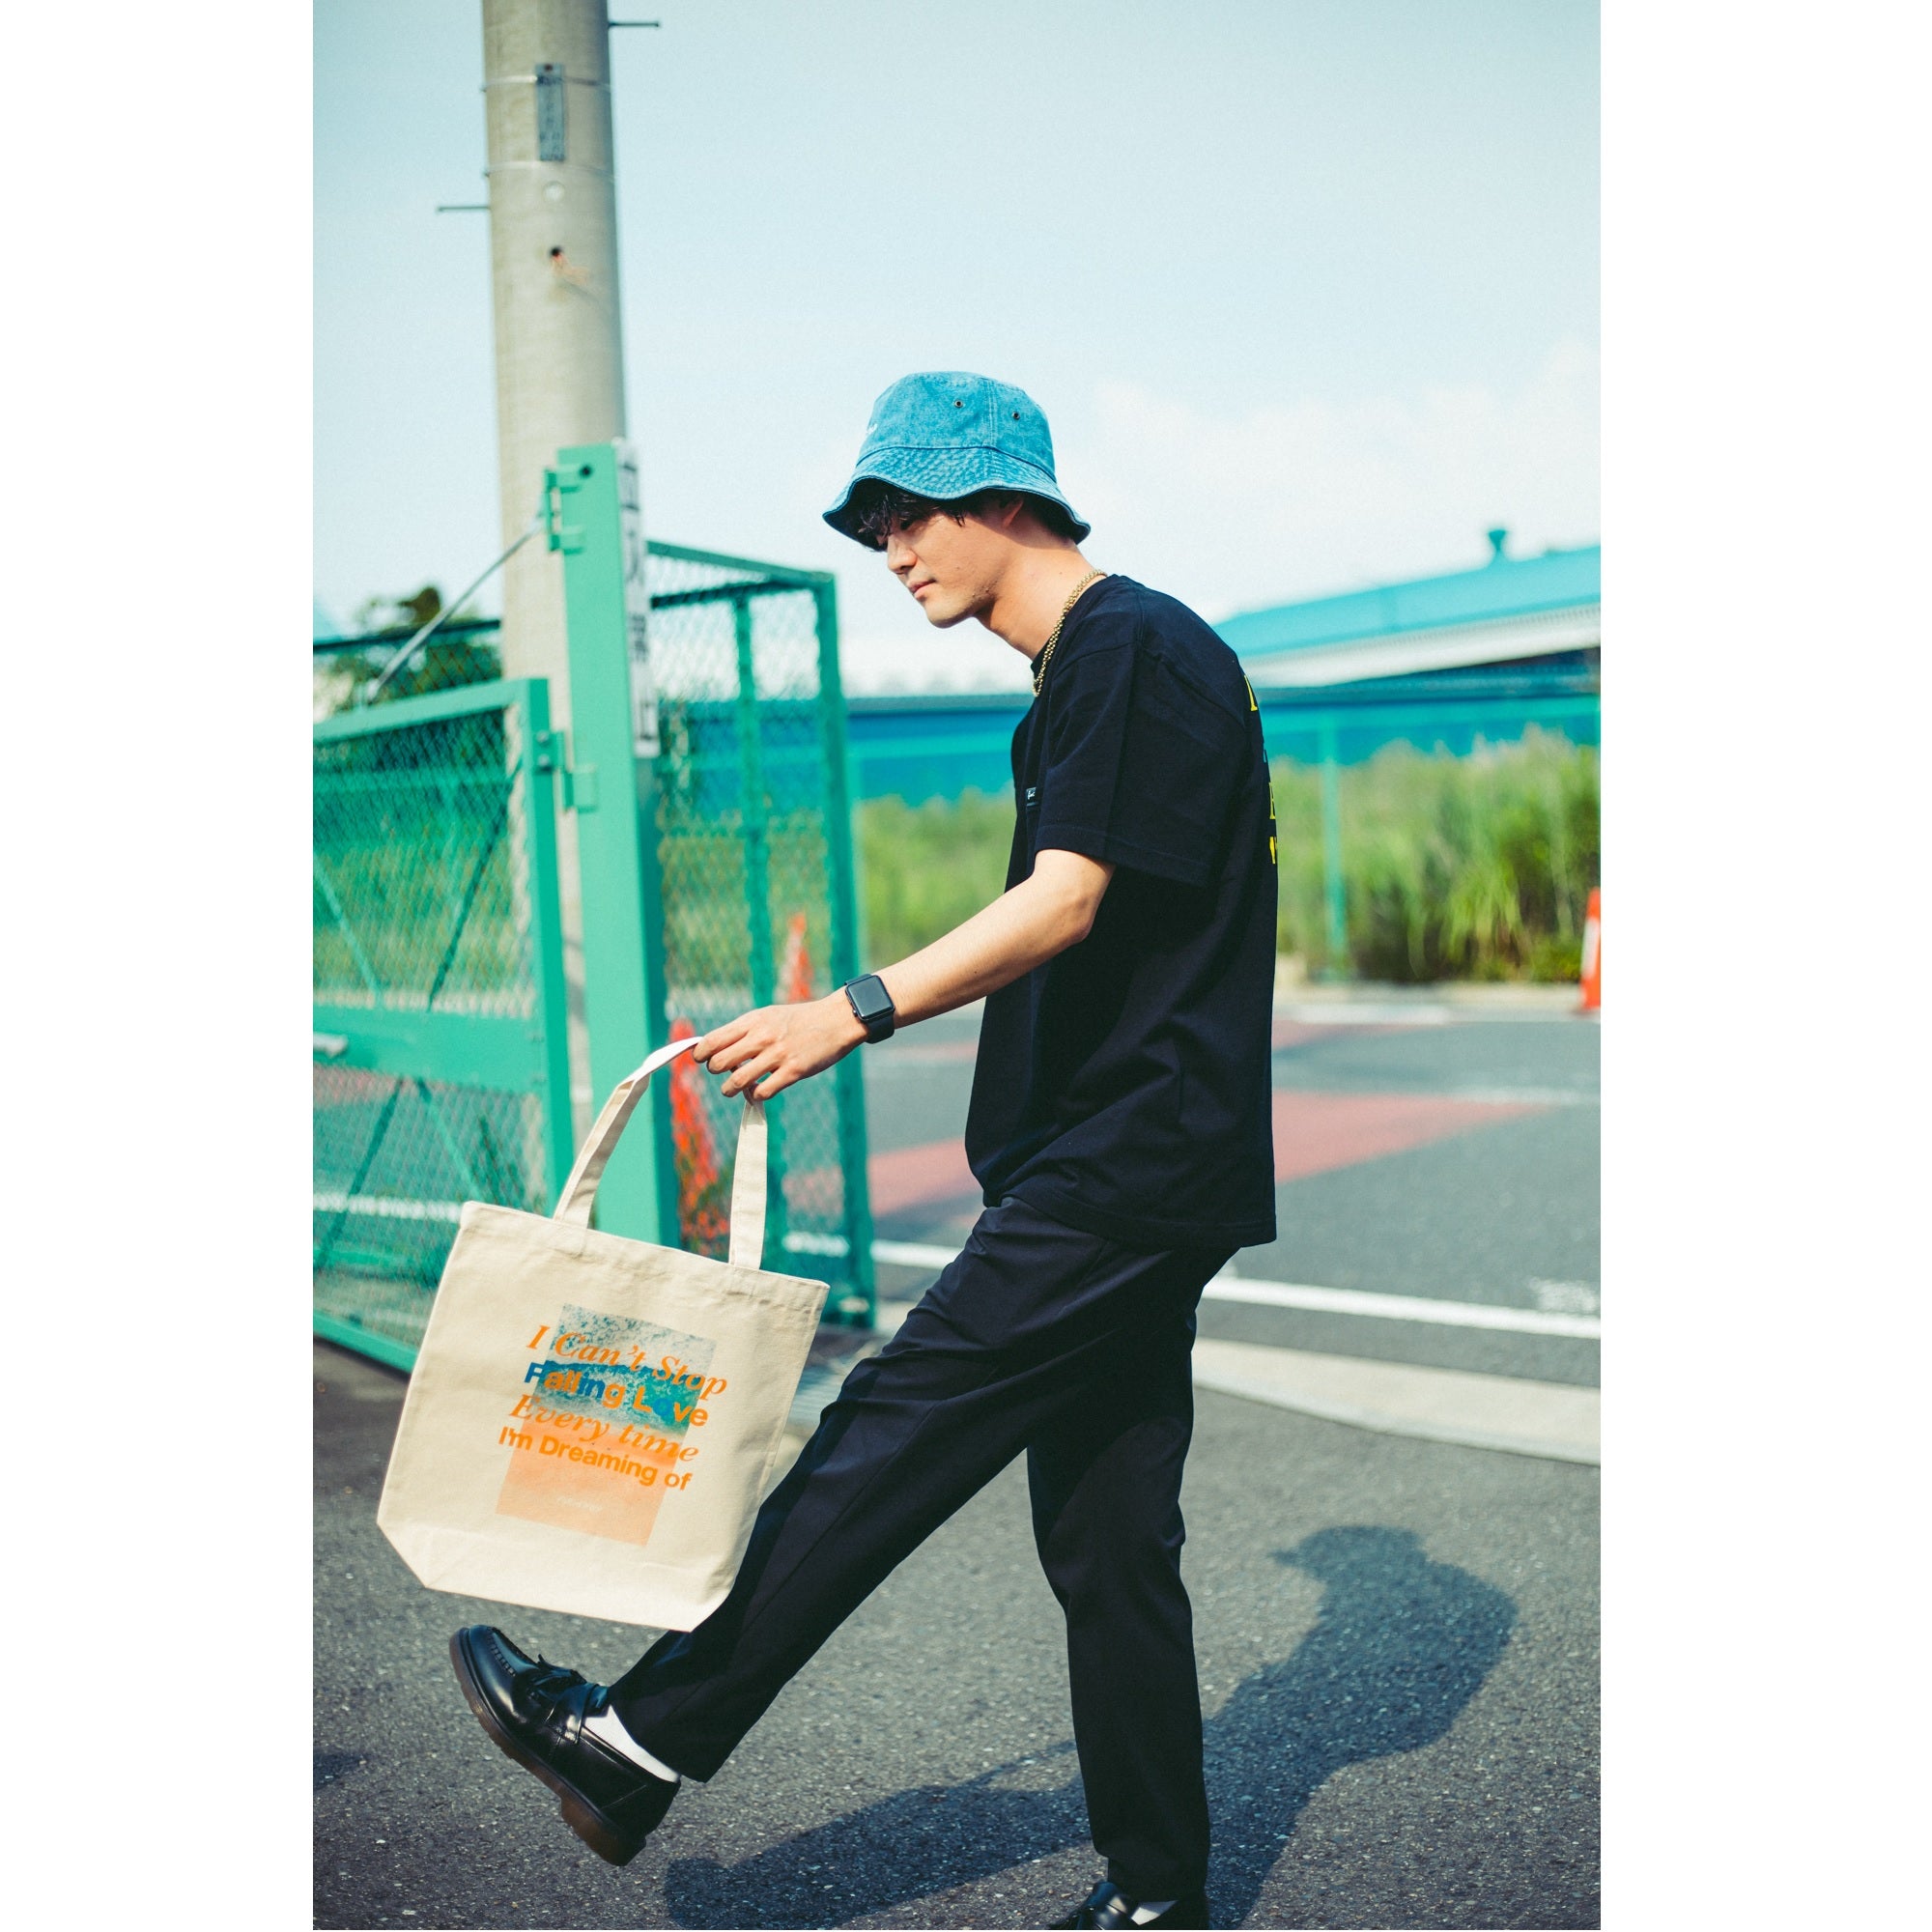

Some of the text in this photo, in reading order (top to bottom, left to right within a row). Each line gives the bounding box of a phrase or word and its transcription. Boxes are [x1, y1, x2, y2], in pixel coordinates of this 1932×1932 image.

[524, 1362, 708, 1427] Falling Love
[526, 1324, 727, 1401] I Can't Stop
[498, 1427, 693, 1491] I'm Dreaming of
[509, 1394, 699, 1462] Every time
